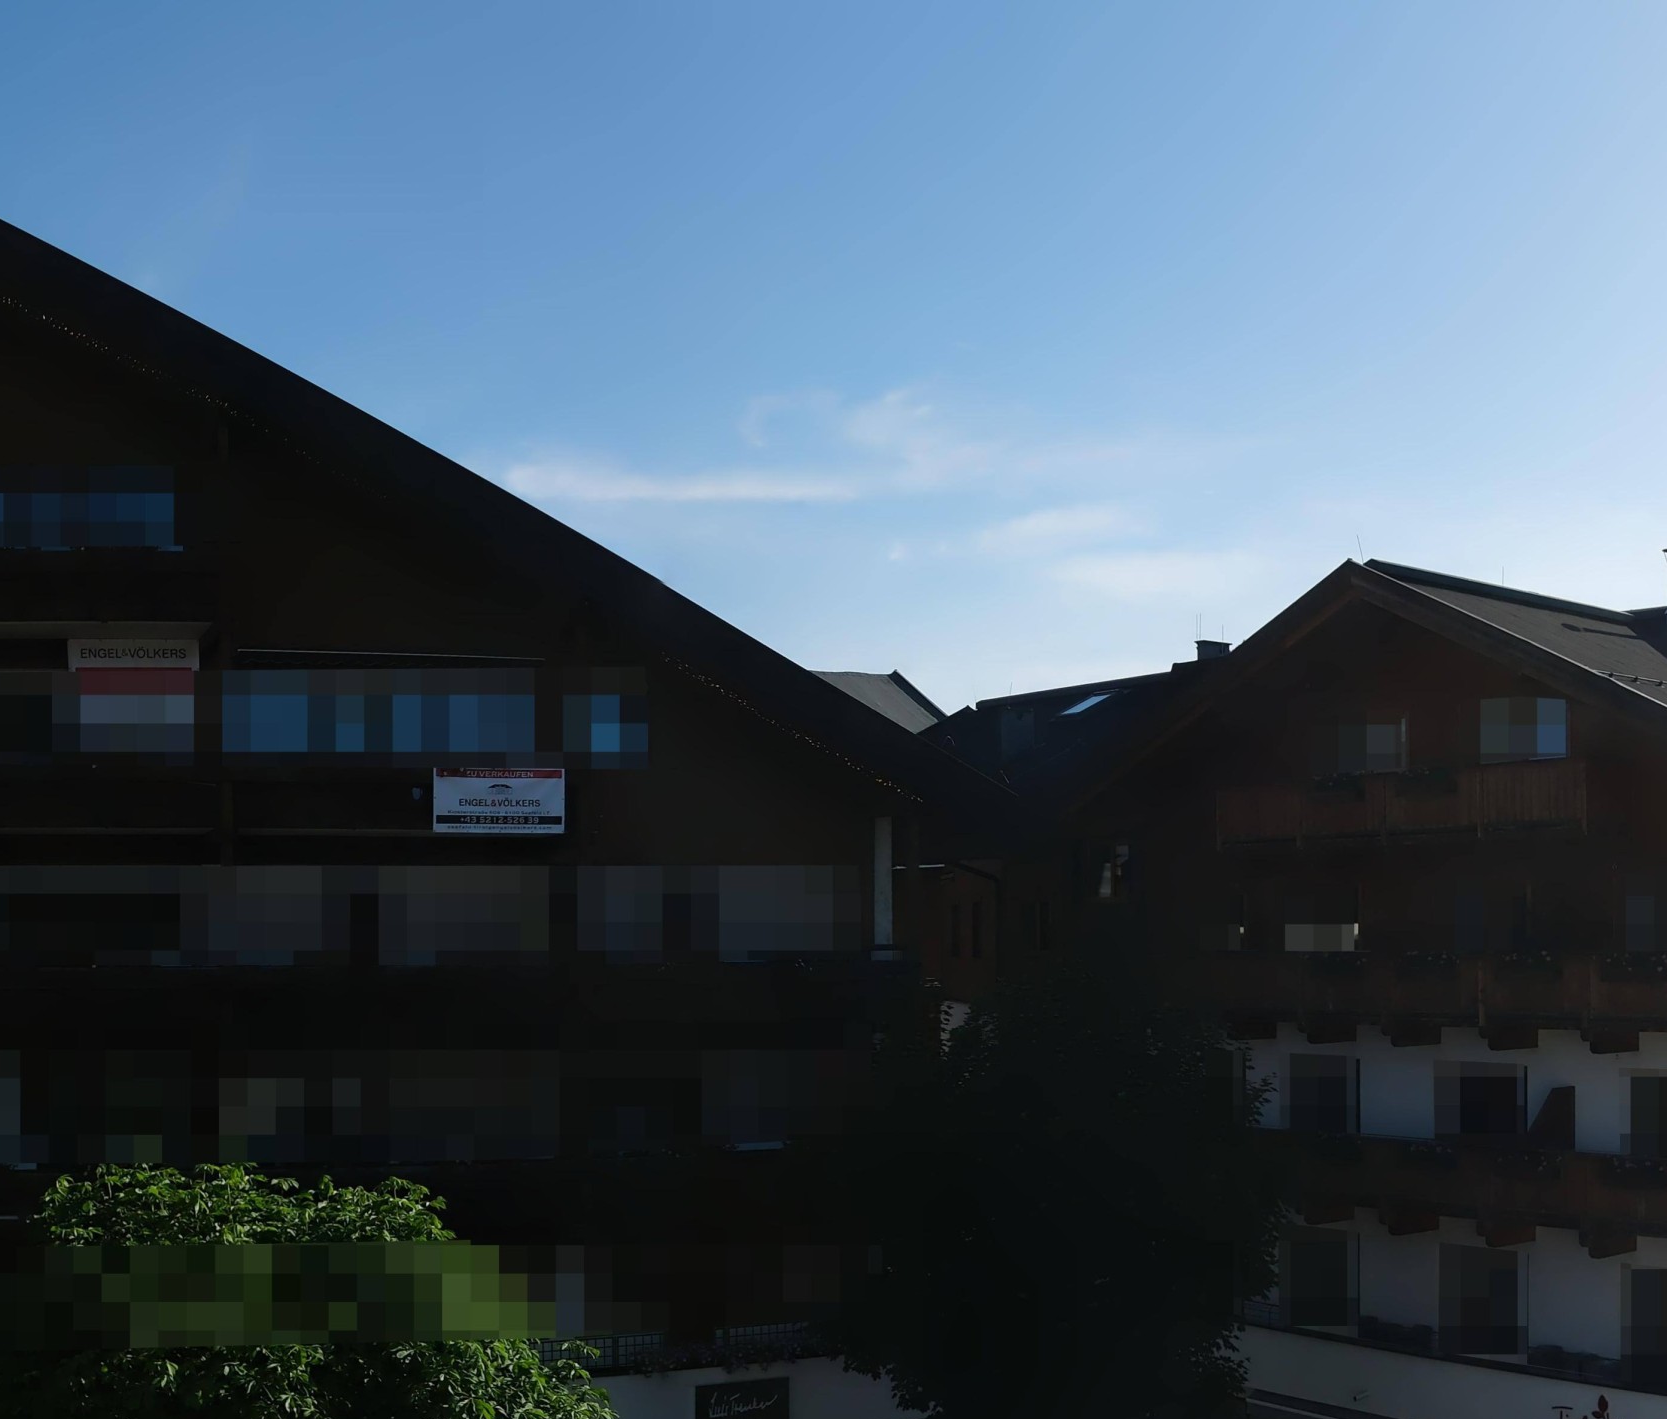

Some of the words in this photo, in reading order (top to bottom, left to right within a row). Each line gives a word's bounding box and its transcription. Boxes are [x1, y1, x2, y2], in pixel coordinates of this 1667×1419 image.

[478, 770, 534, 778] VERKAUFEN
[459, 816, 477, 824] +43
[527, 816, 539, 824] 39
